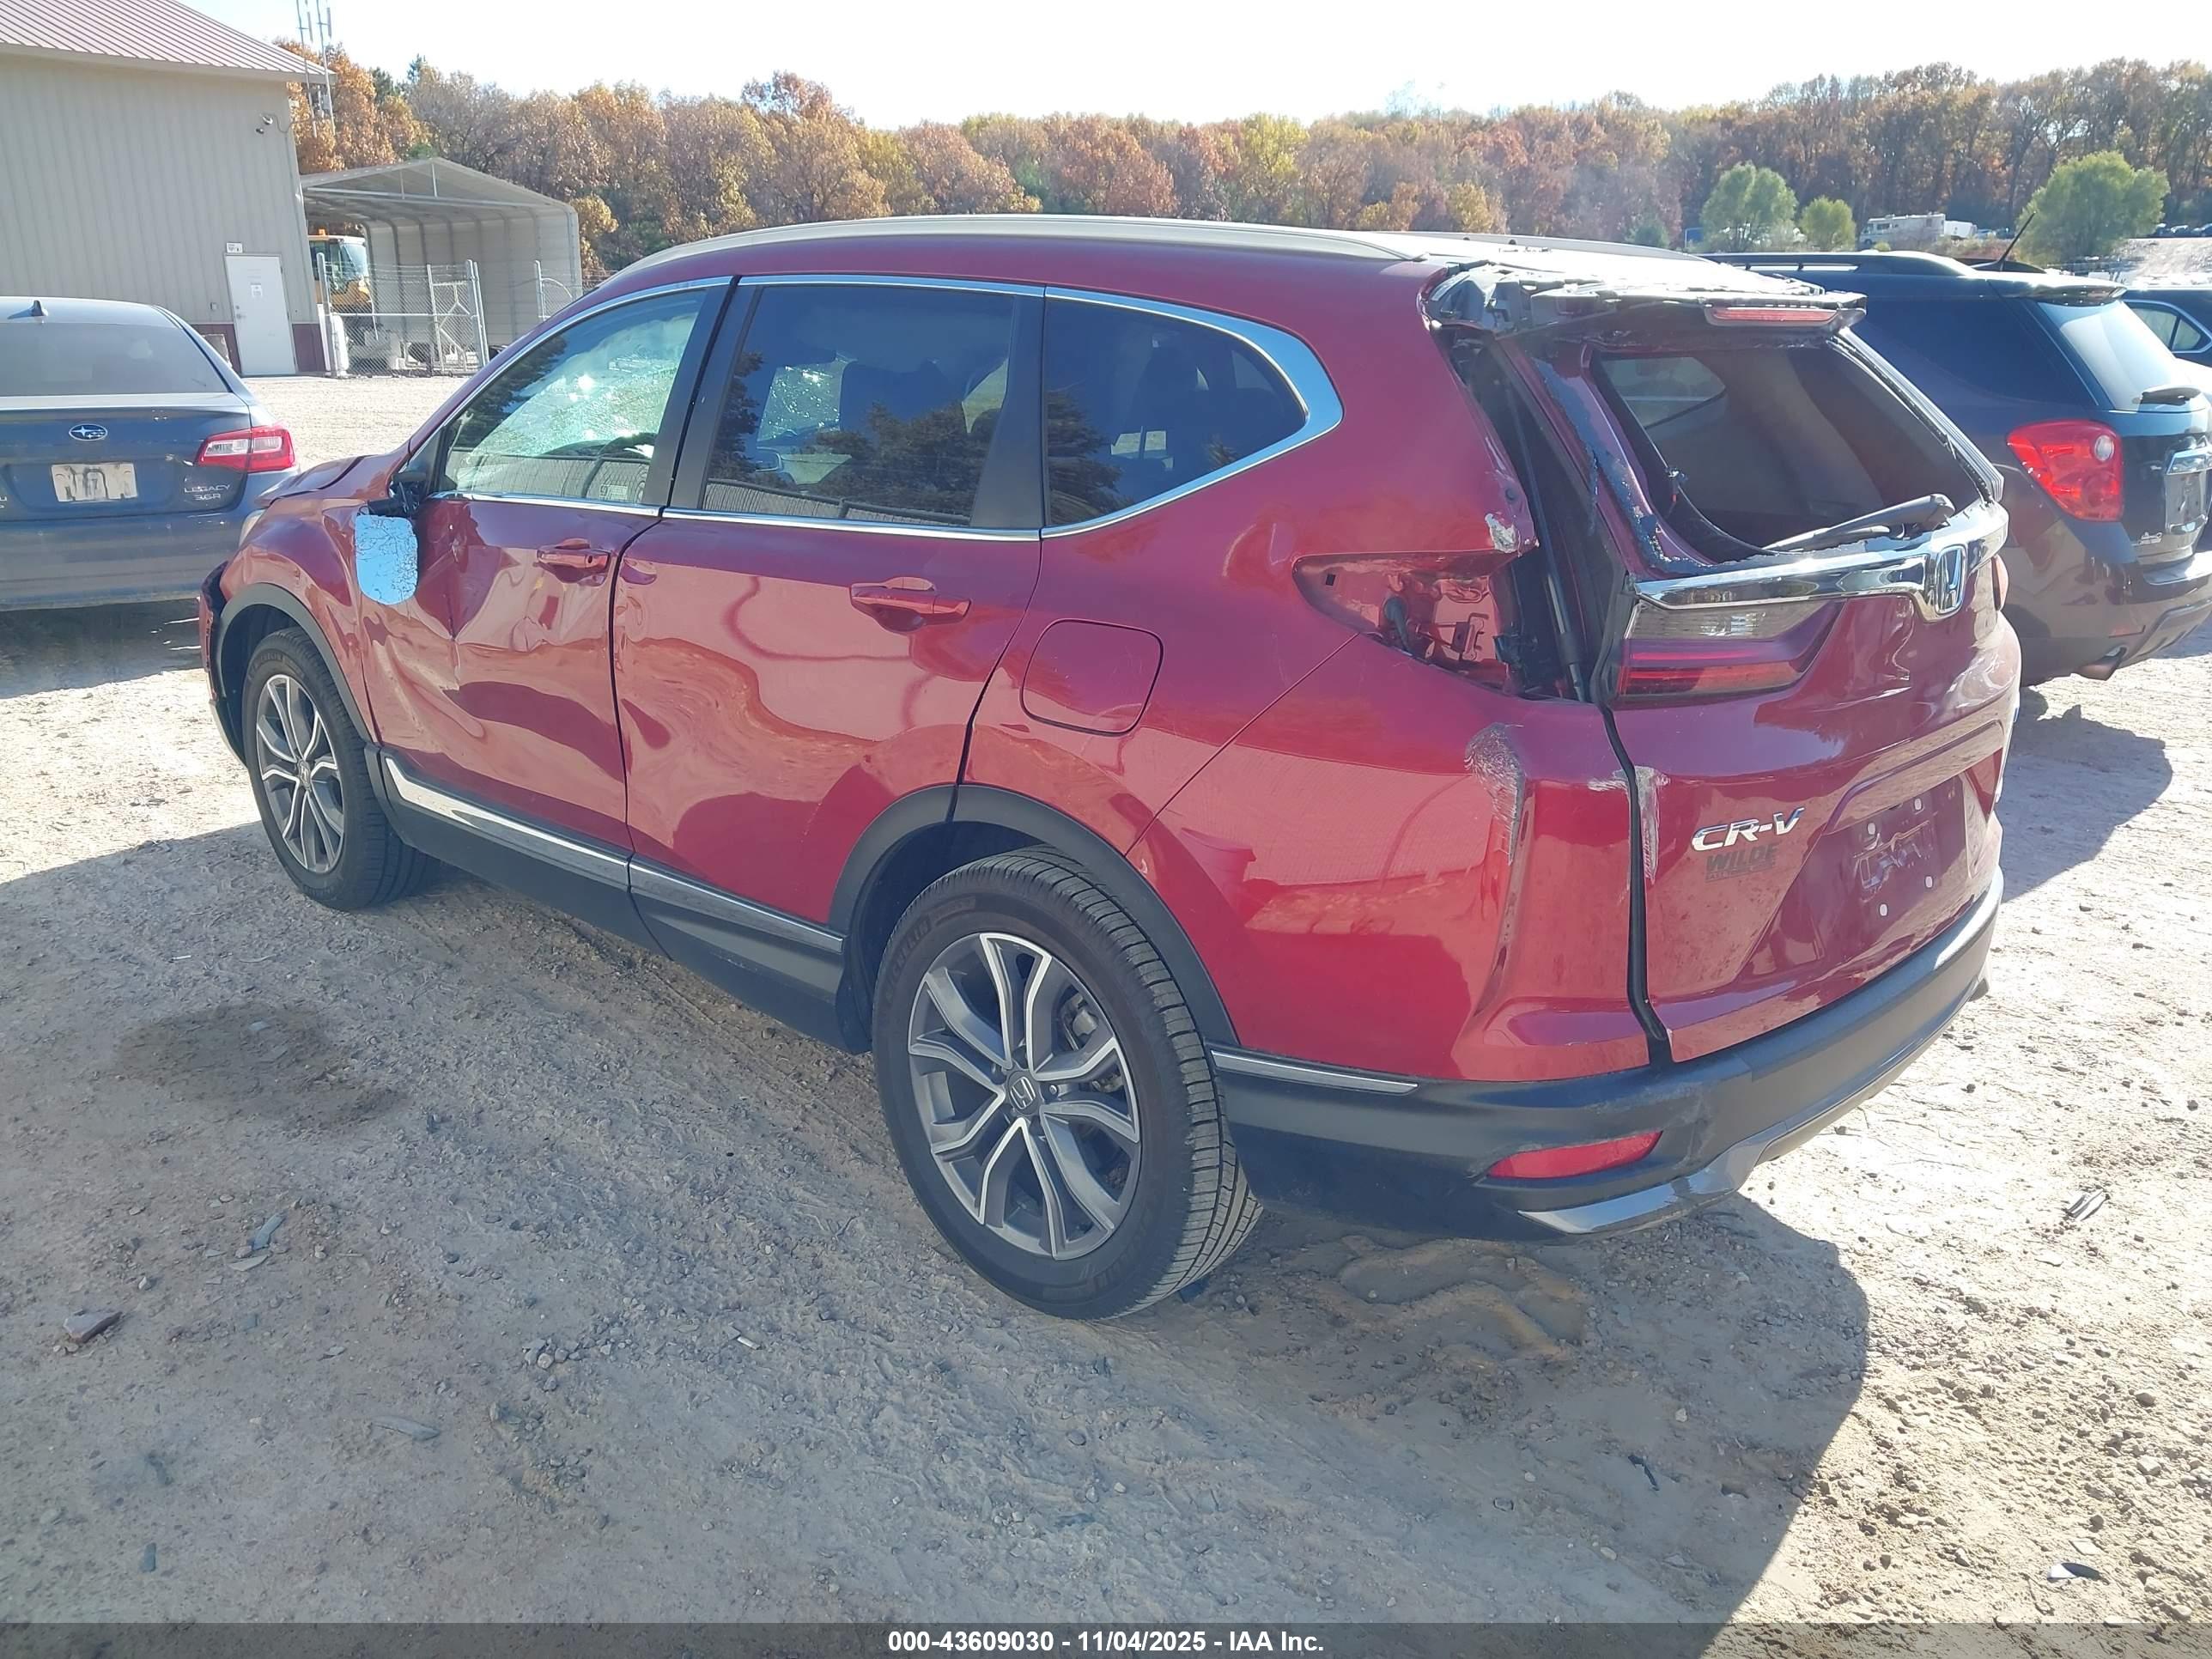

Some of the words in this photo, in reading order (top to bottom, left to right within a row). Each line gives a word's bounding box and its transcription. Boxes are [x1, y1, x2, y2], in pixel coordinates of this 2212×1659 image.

[184, 483, 230, 493] LEGACY
[1691, 806, 1805, 852] CR-V
[1705, 843, 1779, 872] WILDE
